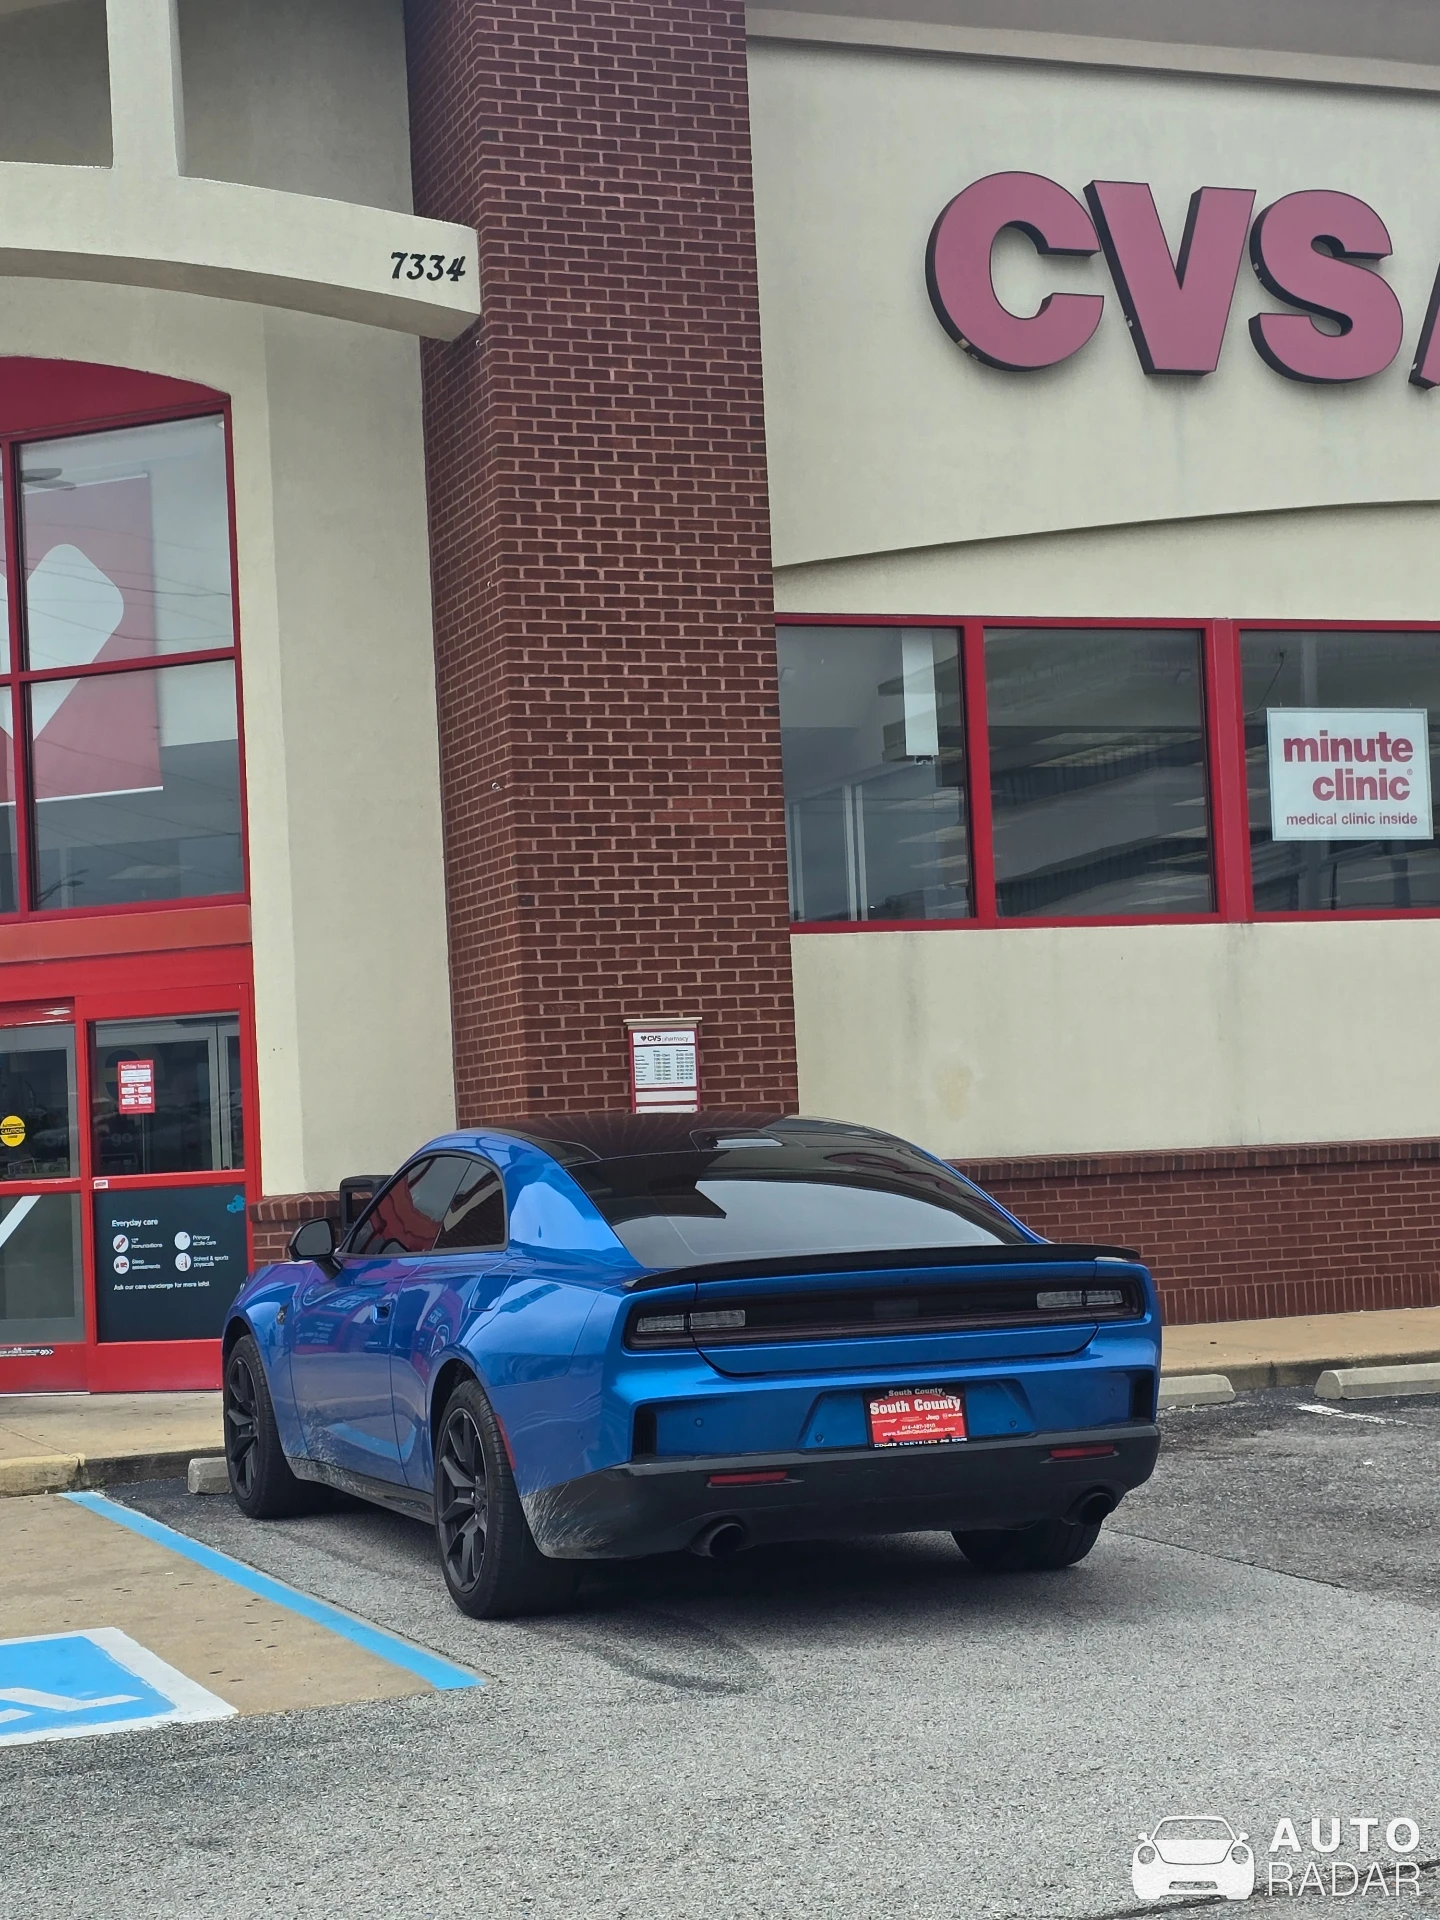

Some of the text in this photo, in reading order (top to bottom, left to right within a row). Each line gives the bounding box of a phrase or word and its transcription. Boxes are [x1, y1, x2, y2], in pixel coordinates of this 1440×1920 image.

[390, 251, 466, 282] 7334
[925, 171, 1404, 384] CVS
[1283, 730, 1414, 763] minute
[1286, 812, 1418, 825] medical clinic inside
[111, 1218, 159, 1228] Everyday care
[888, 1387, 943, 1397] South County
[870, 1398, 961, 1415] South County
